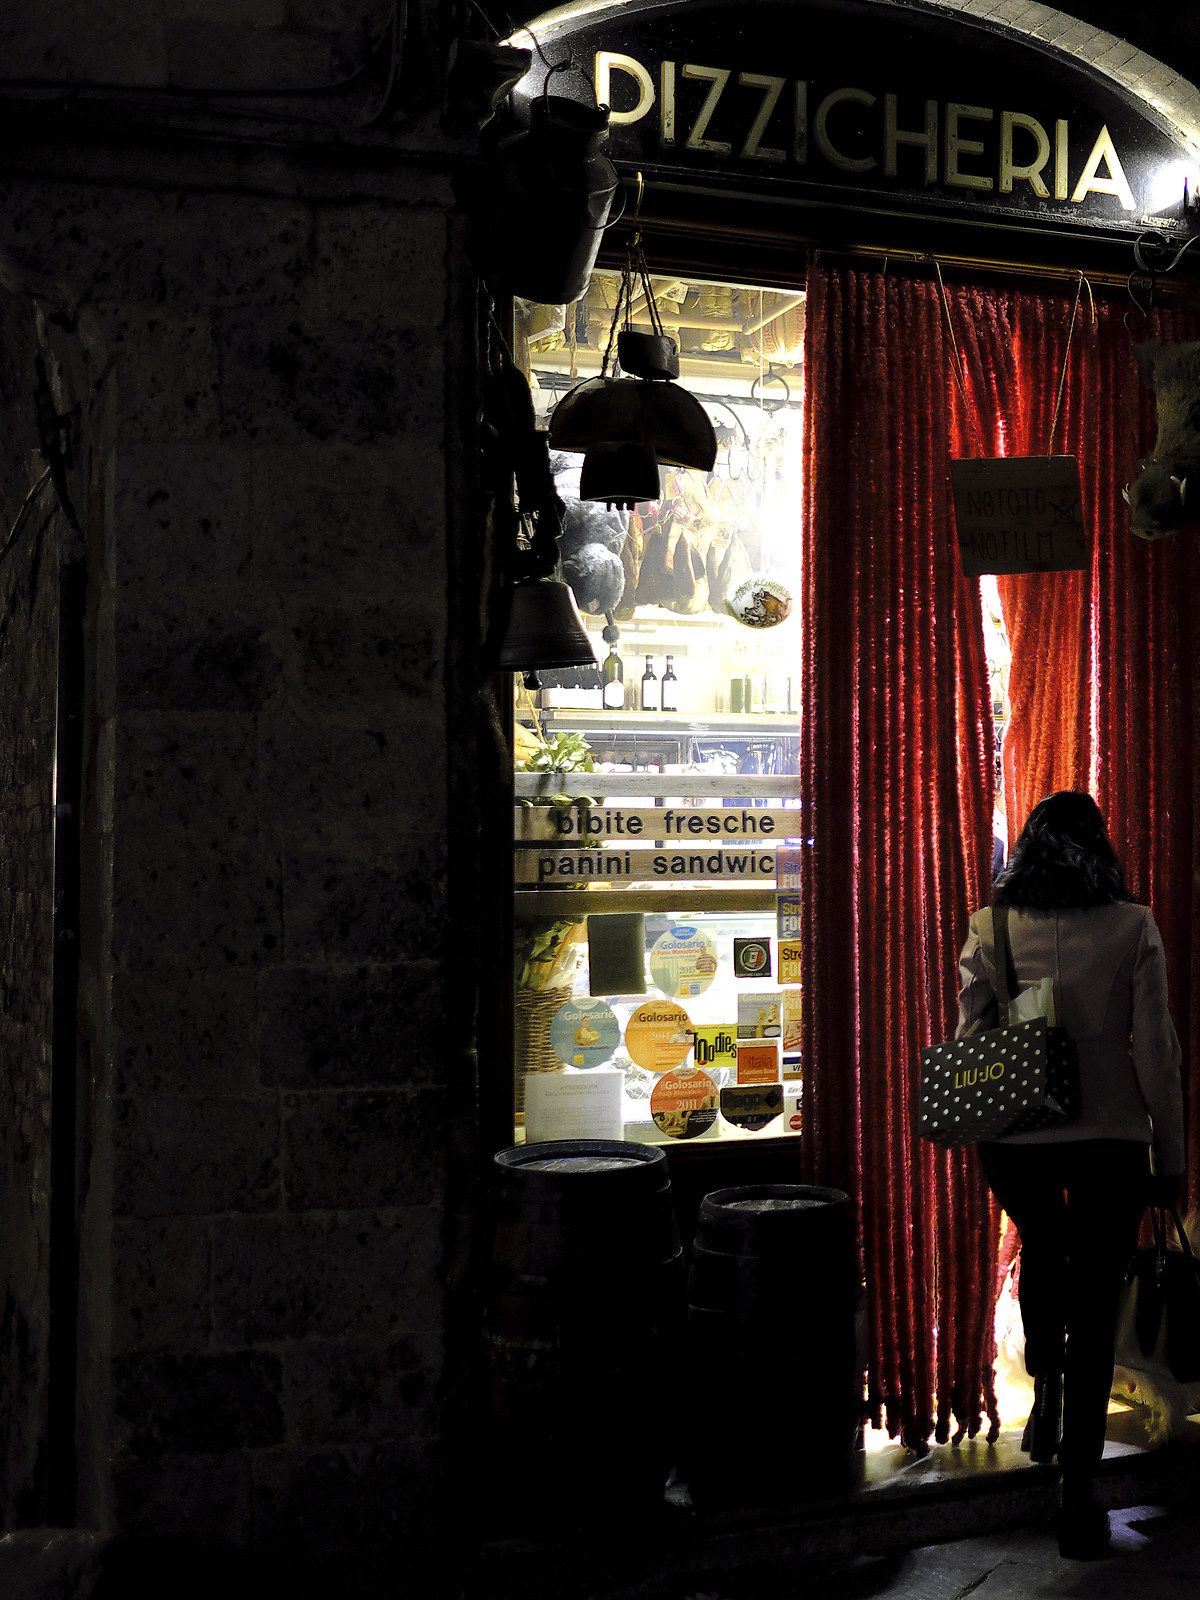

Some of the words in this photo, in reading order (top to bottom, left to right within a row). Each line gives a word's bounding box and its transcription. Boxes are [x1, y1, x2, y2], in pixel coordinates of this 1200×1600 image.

[593, 50, 1137, 212] PIZZICHERIA
[998, 488, 1047, 517] FOTO
[1001, 530, 1054, 562] FILM
[556, 810, 643, 835] bibite
[664, 810, 776, 834] fresche
[538, 851, 632, 880] panini
[653, 850, 775, 875] sandwic
[639, 1011, 688, 1022] Golosario
